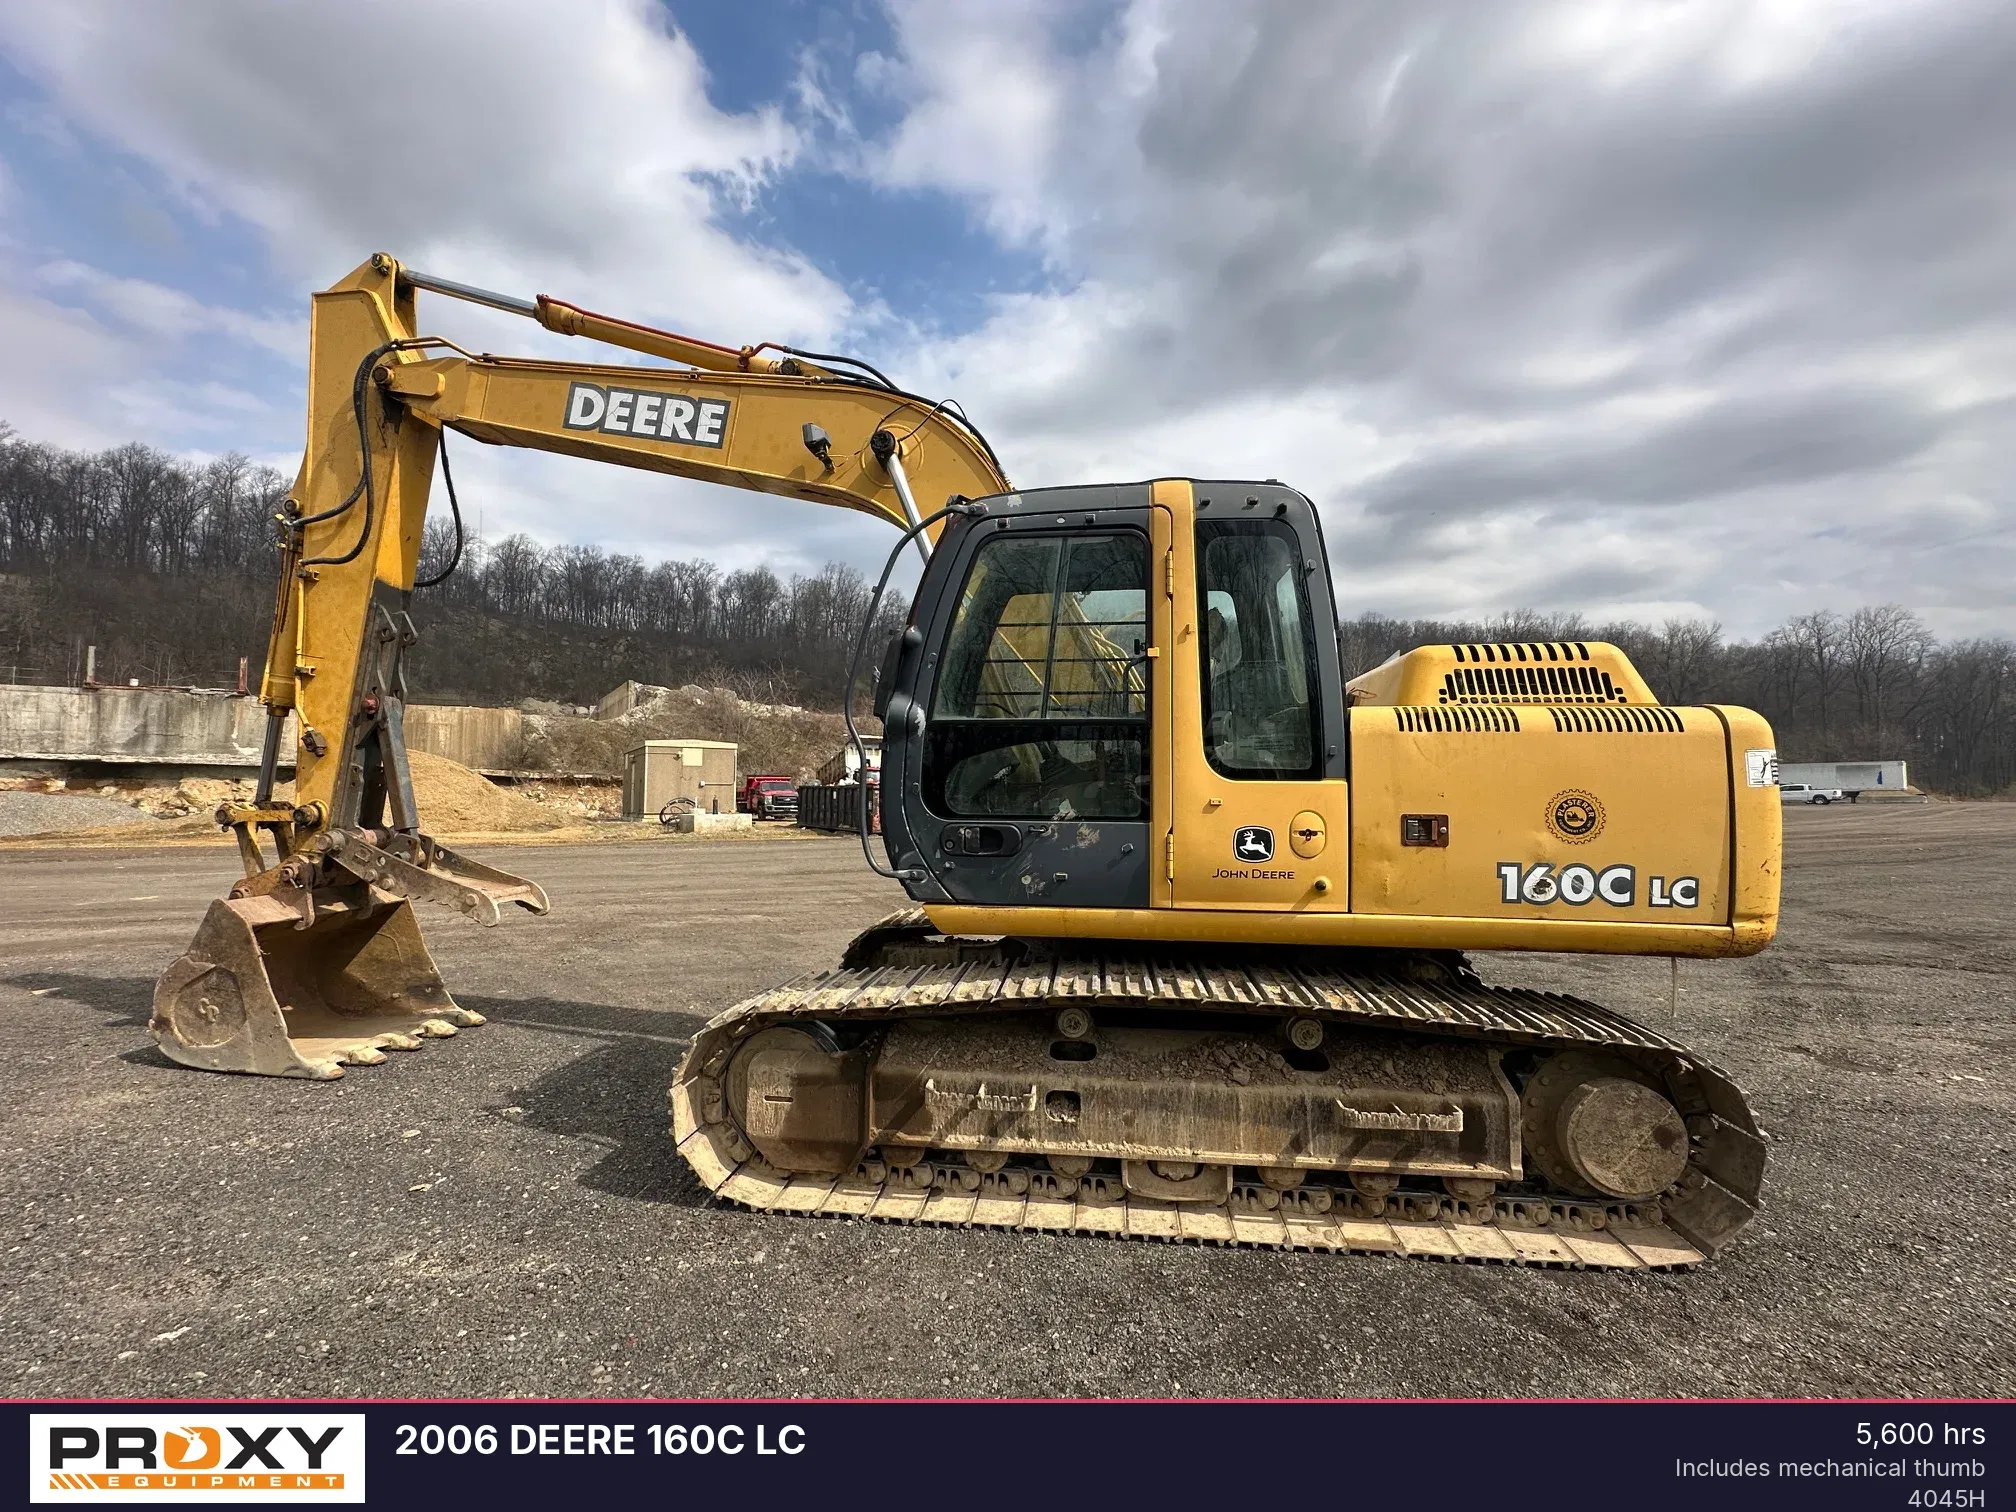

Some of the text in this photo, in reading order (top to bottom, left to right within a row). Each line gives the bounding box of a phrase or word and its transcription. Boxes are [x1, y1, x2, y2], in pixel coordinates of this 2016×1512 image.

[566, 385, 727, 446] DEERE
[1557, 799, 1595, 817] PLASTERER
[1212, 868, 1295, 879] JOHN DEERE
[1499, 864, 1697, 907] 160C LC
